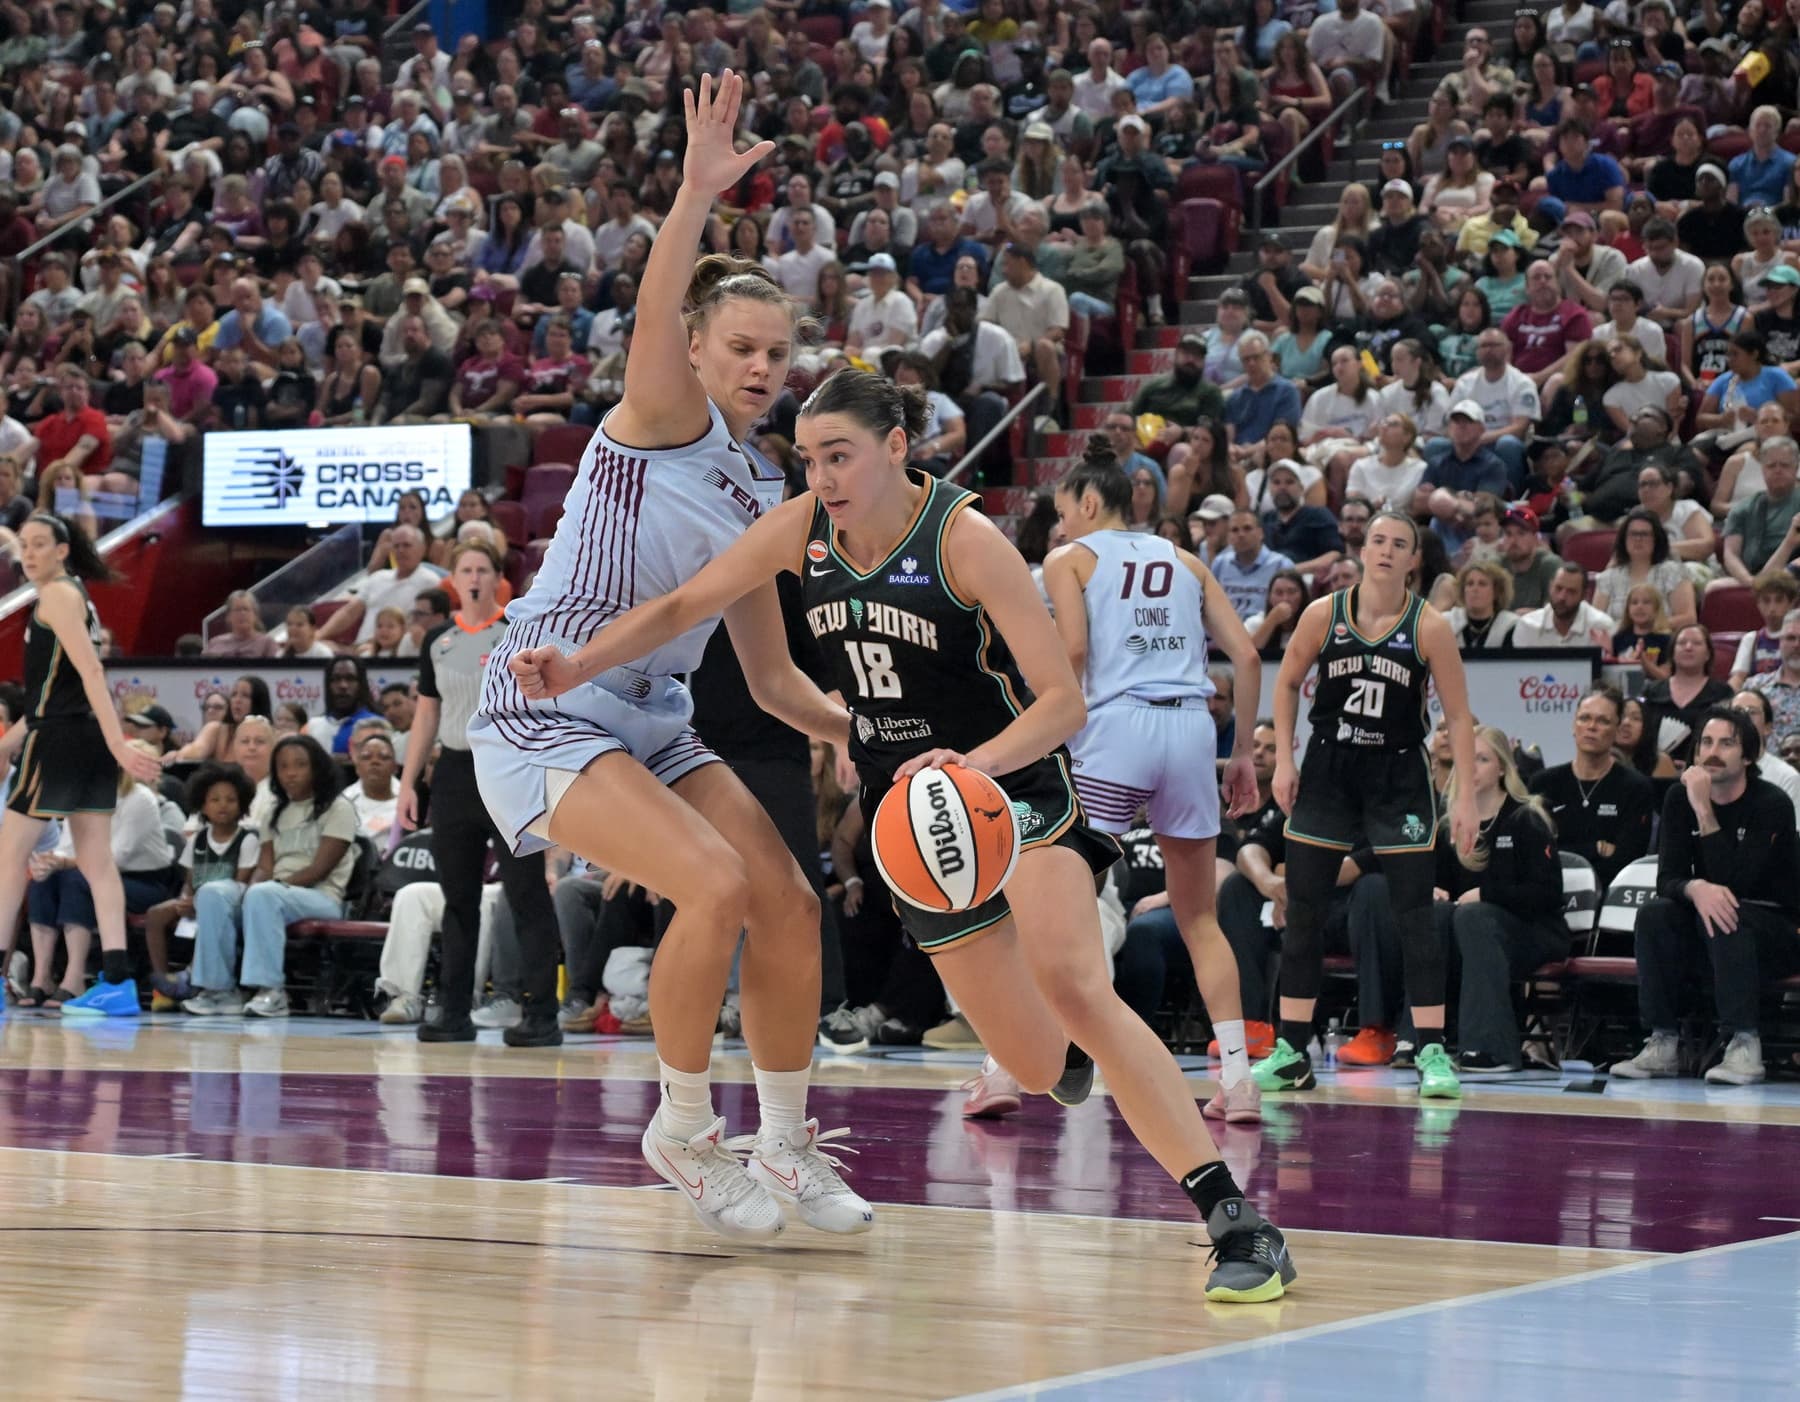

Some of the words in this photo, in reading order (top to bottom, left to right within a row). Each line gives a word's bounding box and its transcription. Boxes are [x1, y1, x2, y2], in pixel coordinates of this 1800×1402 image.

[317, 462, 438, 483] CROSS-
[888, 575, 930, 584] BARCLAYS
[1120, 561, 1173, 600] 10
[806, 601, 848, 640] NEW
[866, 601, 938, 651] YORK
[1134, 608, 1171, 627] CONDE
[1150, 636, 1187, 651] AT&T
[844, 641, 902, 698] 18
[1328, 656, 1363, 679] NEW
[1371, 655, 1411, 687] YORK
[1343, 678, 1386, 718] 20
[1520, 676, 1579, 699] Coors
[1526, 700, 1573, 712] LIGHT
[876, 717, 926, 729] Liberty
[880, 724, 933, 742] Mutual
[926, 780, 965, 878] Wilson
